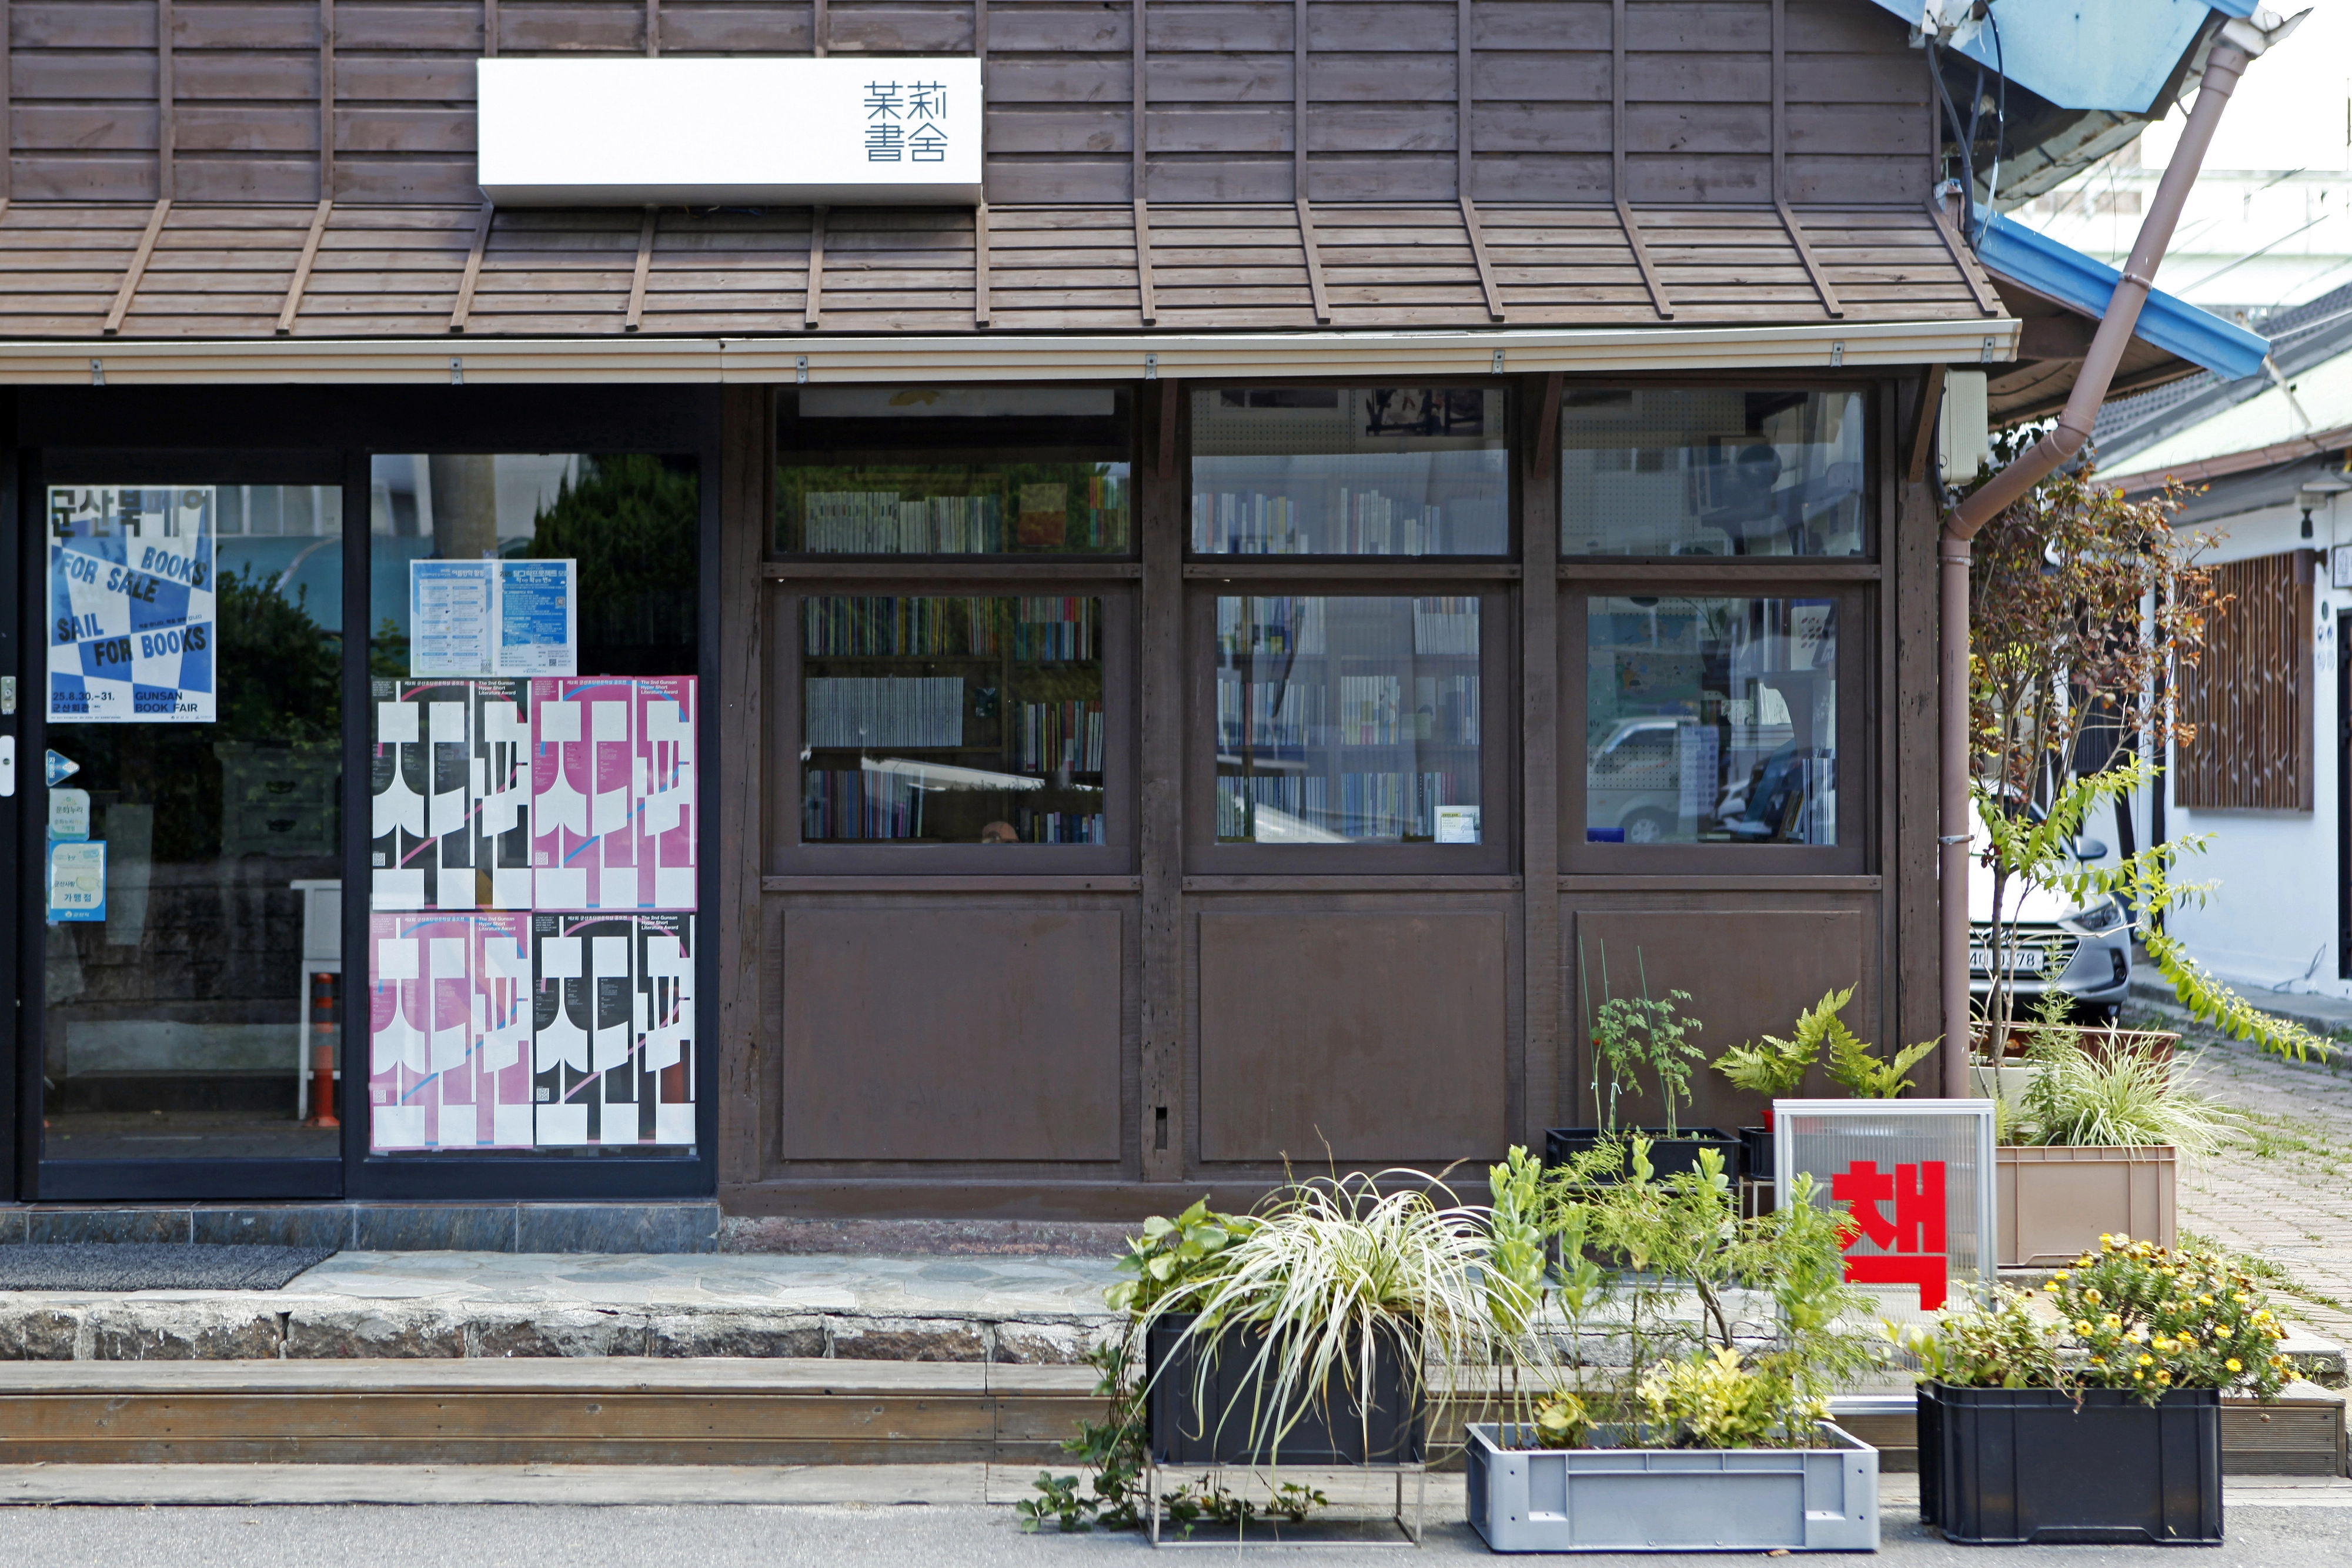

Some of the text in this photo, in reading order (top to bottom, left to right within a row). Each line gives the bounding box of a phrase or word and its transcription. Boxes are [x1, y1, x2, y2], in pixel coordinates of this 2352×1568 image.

[864, 81, 947, 120] 茉莉
[52, 490, 212, 537] 군산북페어
[58, 552, 160, 603] FOR SALE
[141, 546, 206, 586] BOOKS
[57, 613, 104, 642] SAIL
[94, 626, 206, 667] FOR BOOKS
[53, 704, 90, 713] 군산회관
[135, 692, 183, 701] GUNSAN
[135, 704, 198, 713] BOOK FAIR
[56, 804, 83, 814] 문화누리
[1832, 1161, 1947, 1310] 책
